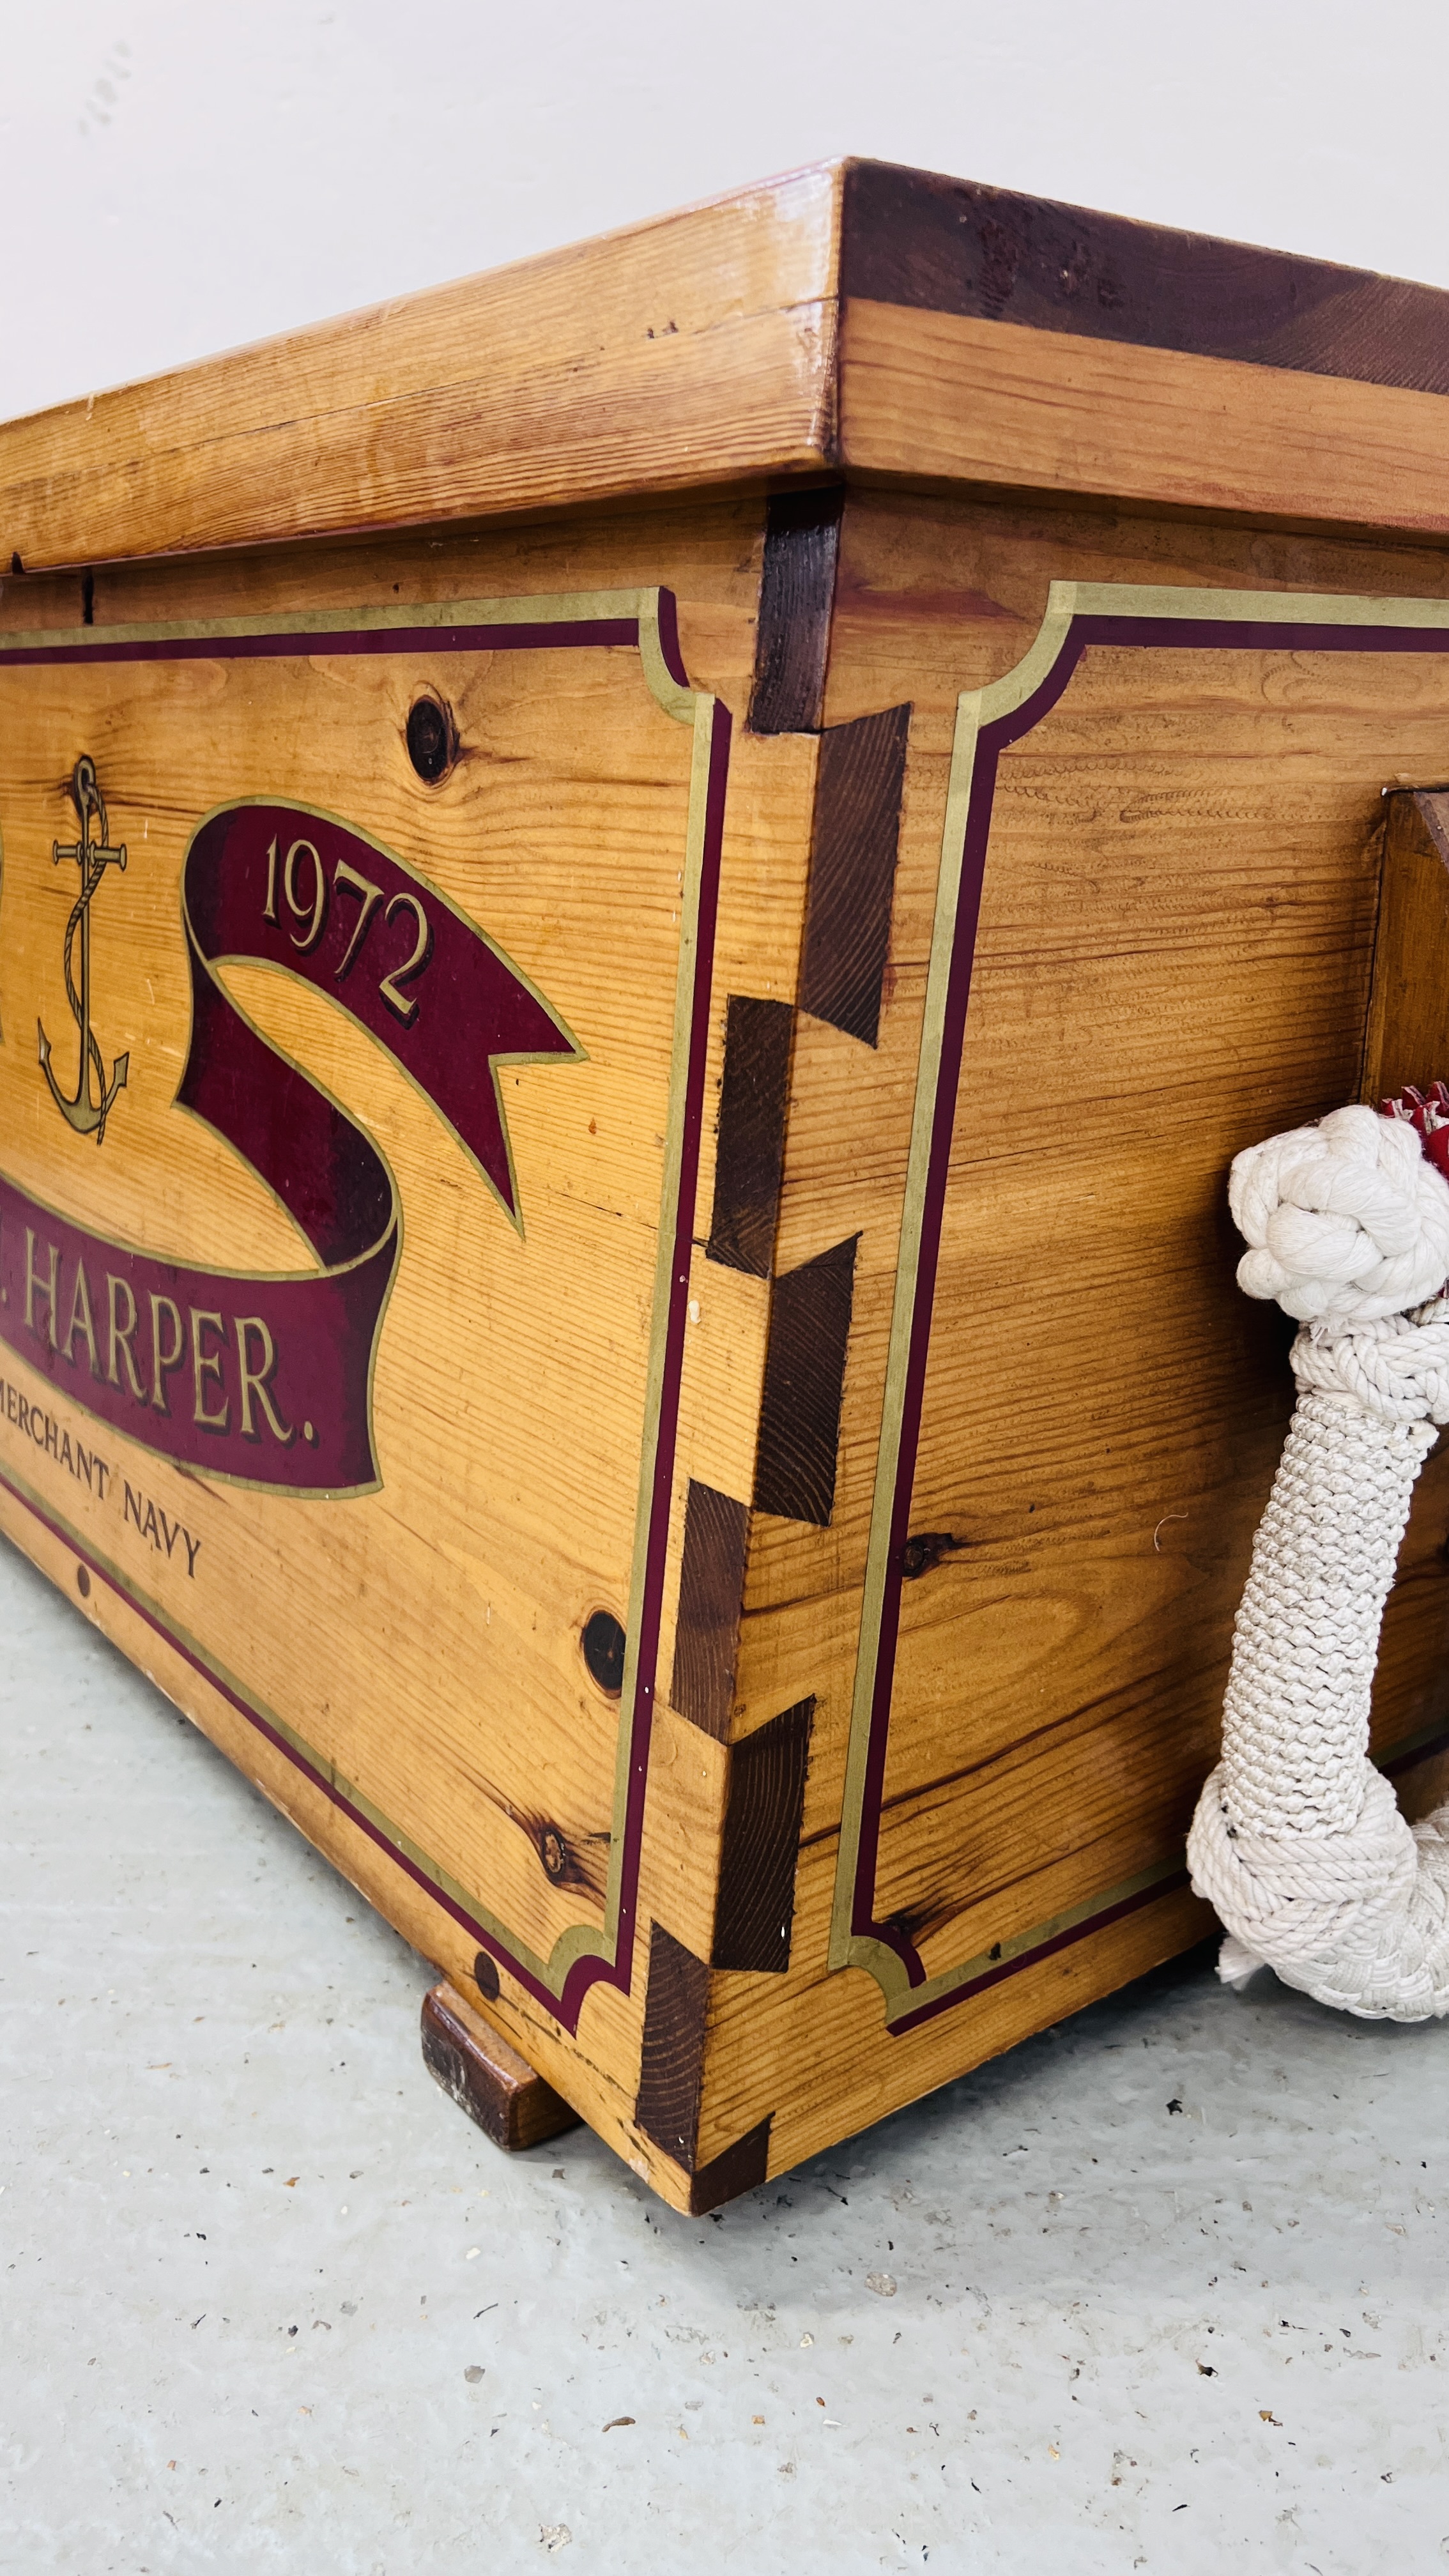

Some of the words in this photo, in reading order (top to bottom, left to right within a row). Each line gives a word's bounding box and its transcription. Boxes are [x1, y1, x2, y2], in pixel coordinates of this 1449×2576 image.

[262, 832, 429, 1016] 1972
[23, 1225, 315, 1443] HARPER.
[123, 1479, 201, 1579] NAVY
